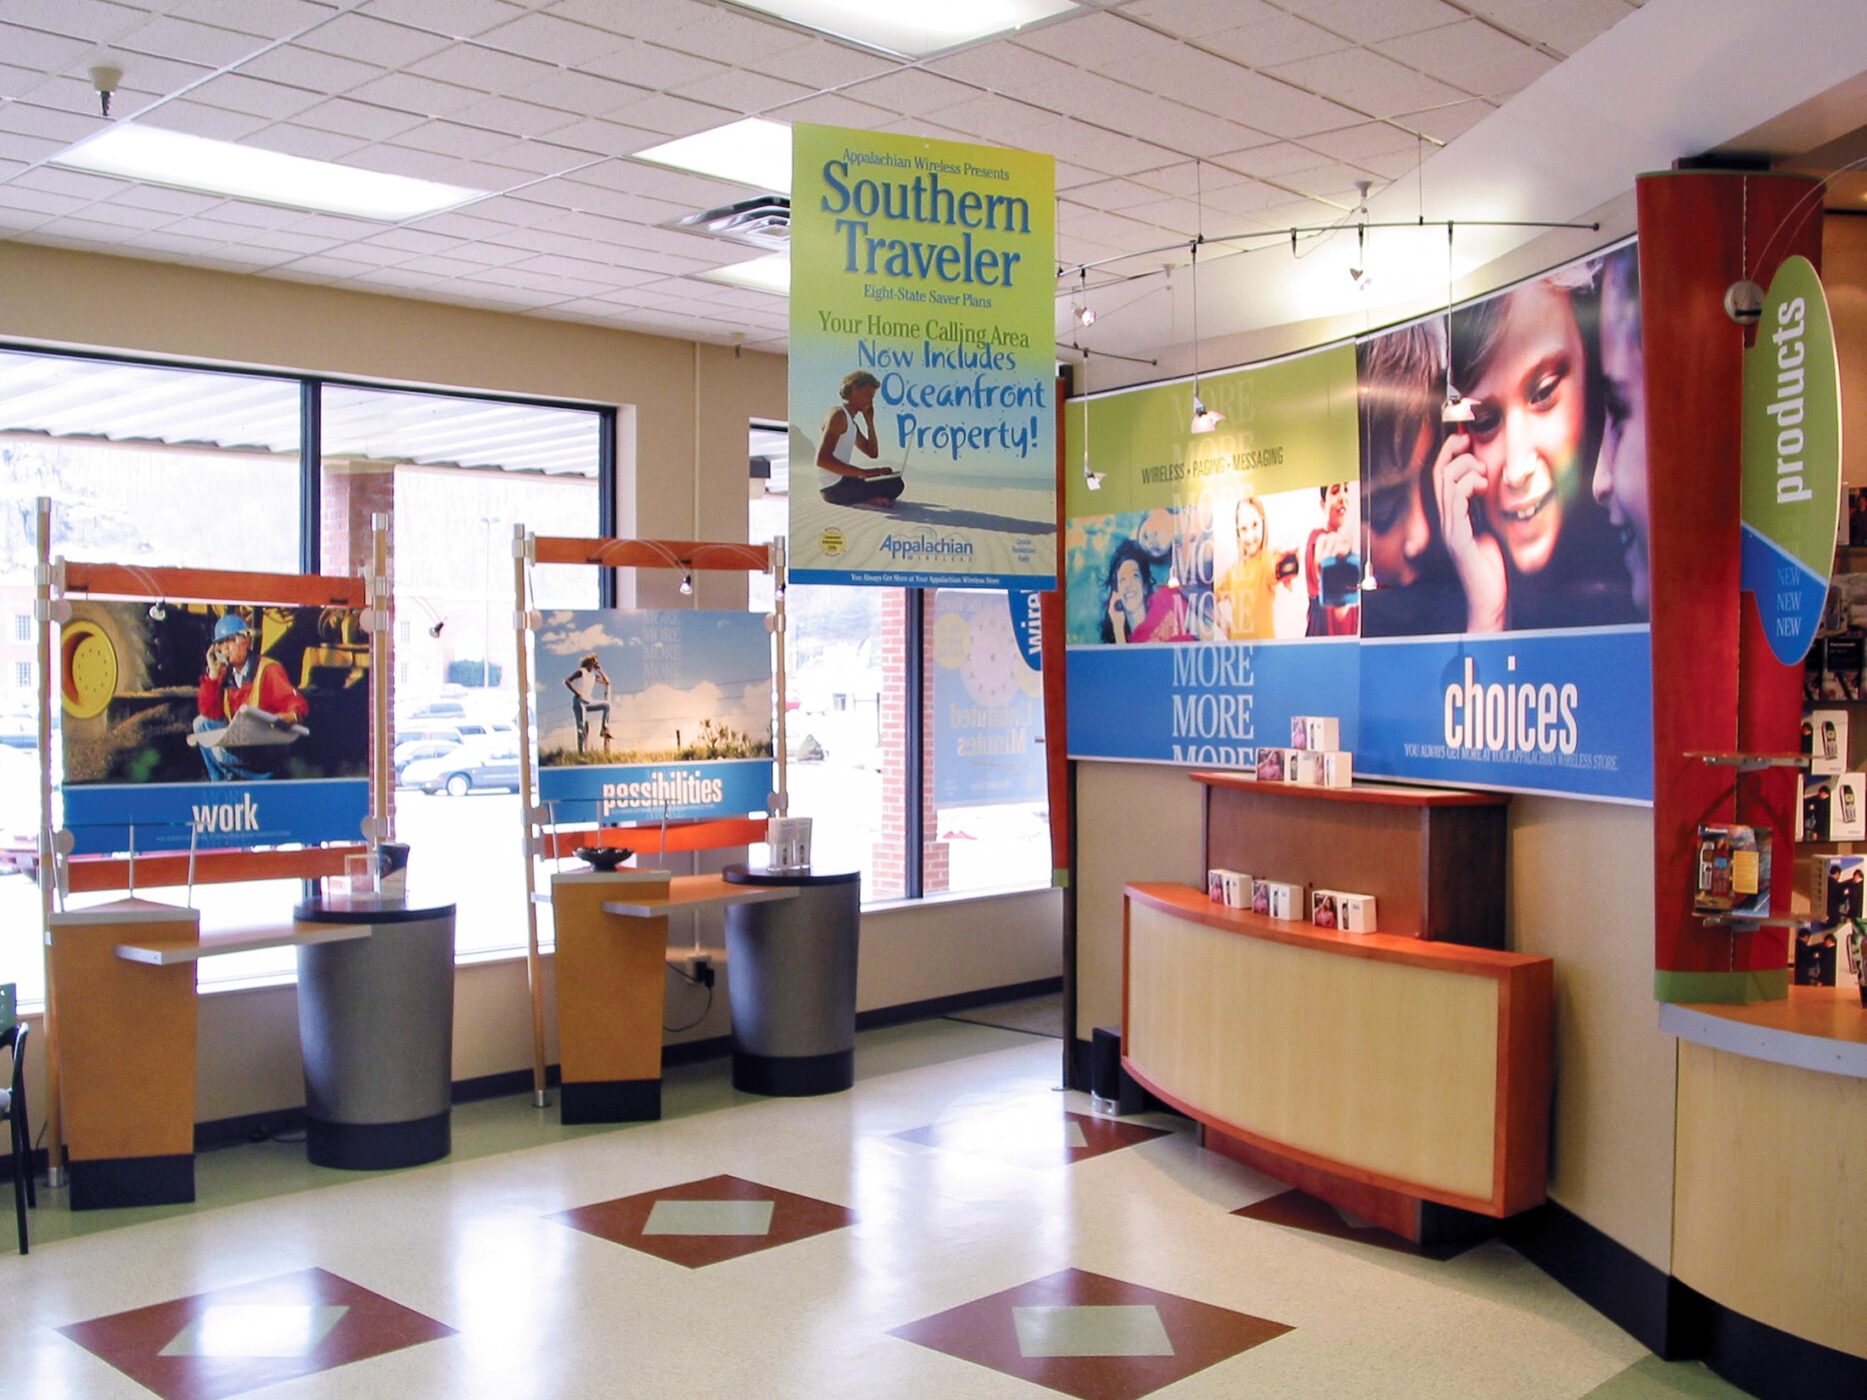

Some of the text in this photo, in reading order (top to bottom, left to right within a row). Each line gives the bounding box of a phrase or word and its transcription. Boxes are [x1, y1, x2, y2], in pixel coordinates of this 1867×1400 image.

[842, 148, 1010, 181] Appalachian Wireless Presents
[821, 160, 1031, 234] Southern
[835, 218, 1020, 287] Traveler
[864, 284, 992, 308] Eight-State Saver Plans
[818, 310, 1030, 349] Your Home Calling Area
[858, 340, 1016, 371] Now Includes
[880, 372, 1047, 409] Oceanfront
[1767, 296, 1813, 504] products
[896, 413, 1038, 460] Property!
[1141, 446, 1284, 485] WIRELESS PAGING MESSAGING
[879, 534, 973, 559] Appalachian
[863, 574, 882, 582] Always
[882, 574, 892, 582] Get
[929, 576, 961, 584] Appalachian
[1777, 567, 1801, 586] NEW
[1172, 588, 1255, 637] MOE
[1777, 591, 1802, 611] NEW
[1020, 589, 1041, 655] wire
[1776, 617, 1801, 637] NEW
[1172, 645, 1255, 687] MORE
[1172, 694, 1255, 740] MORE
[1444, 655, 1578, 755] choices
[1404, 744, 1420, 757] YOU
[1420, 745, 1446, 759] ALWAYS
[1446, 746, 1460, 760] GET
[1461, 748, 1482, 762] MORE
[1492, 751, 1512, 763] YOUR
[1512, 751, 1556, 766] APPALACHIAN
[1557, 753, 1592, 768] WIRELESS
[191, 792, 259, 833] work
[602, 770, 723, 817] possibilities
